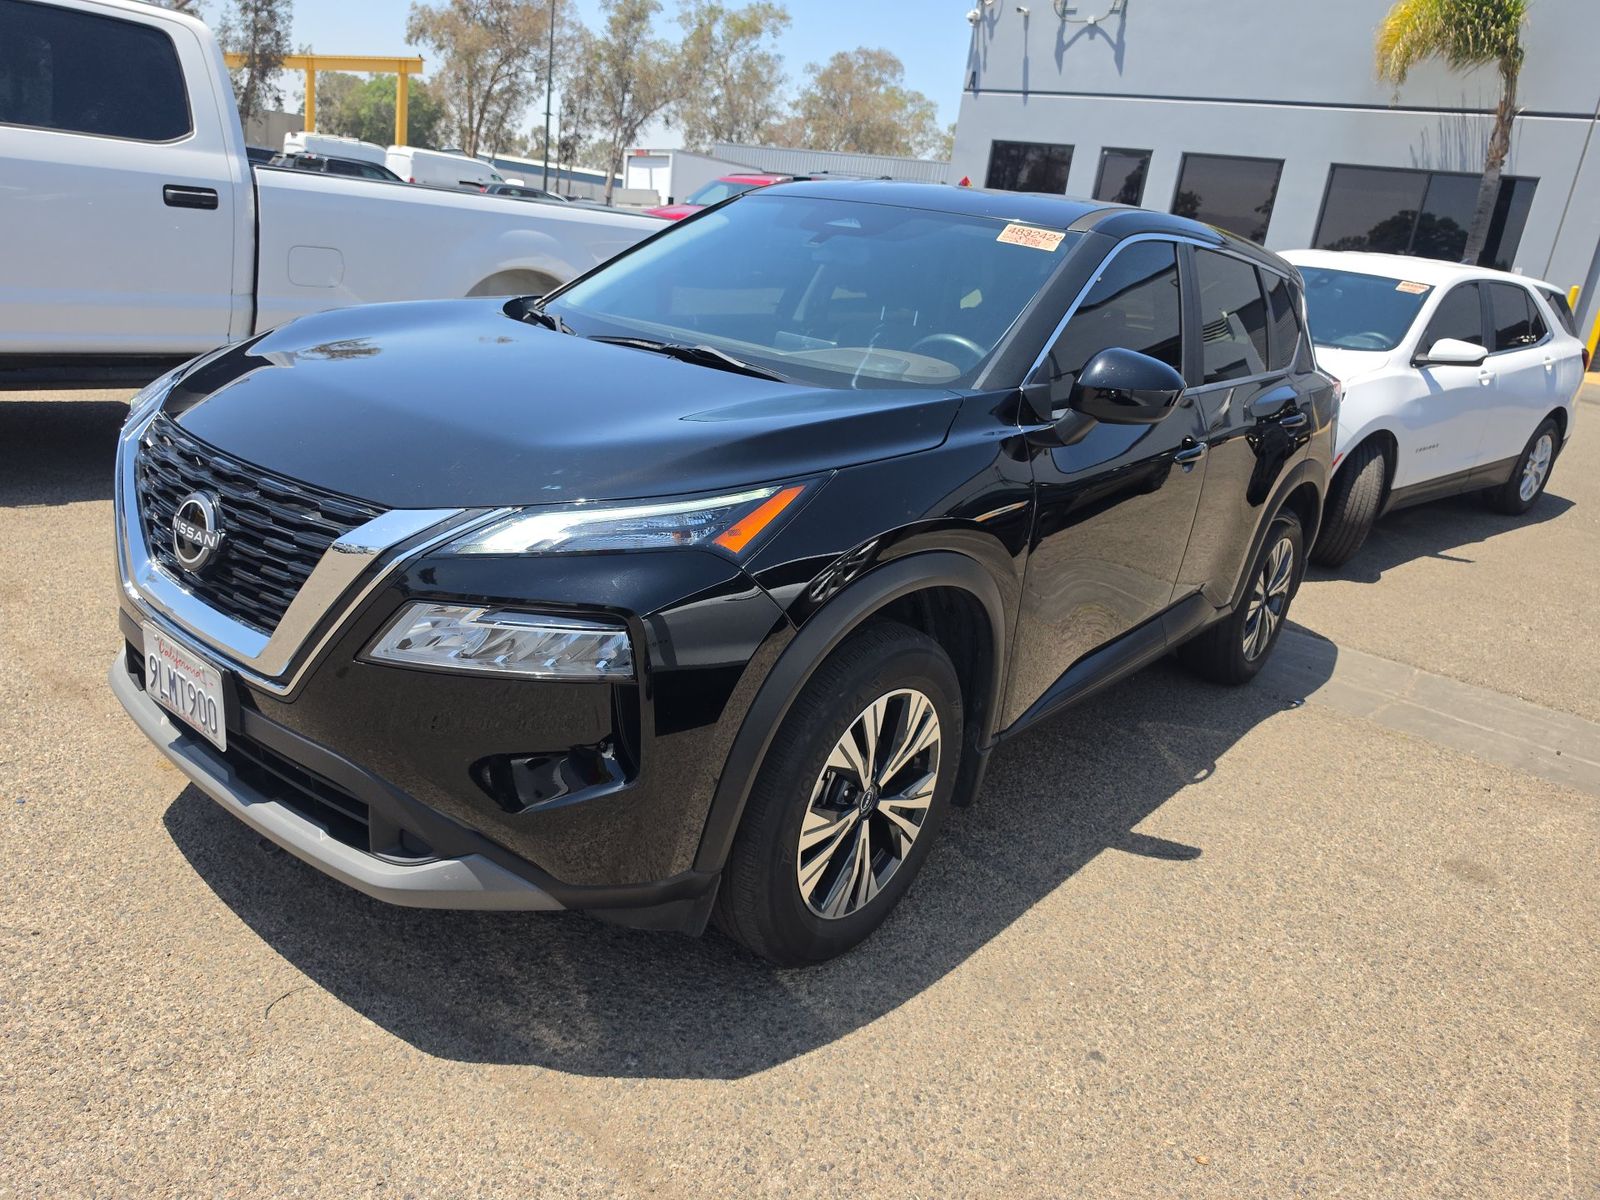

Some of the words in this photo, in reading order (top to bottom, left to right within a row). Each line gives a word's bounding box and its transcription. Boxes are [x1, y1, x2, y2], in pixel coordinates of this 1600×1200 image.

[172, 514, 216, 547] NISSAN
[158, 639, 204, 682] California
[149, 653, 217, 735] 9LMT900
